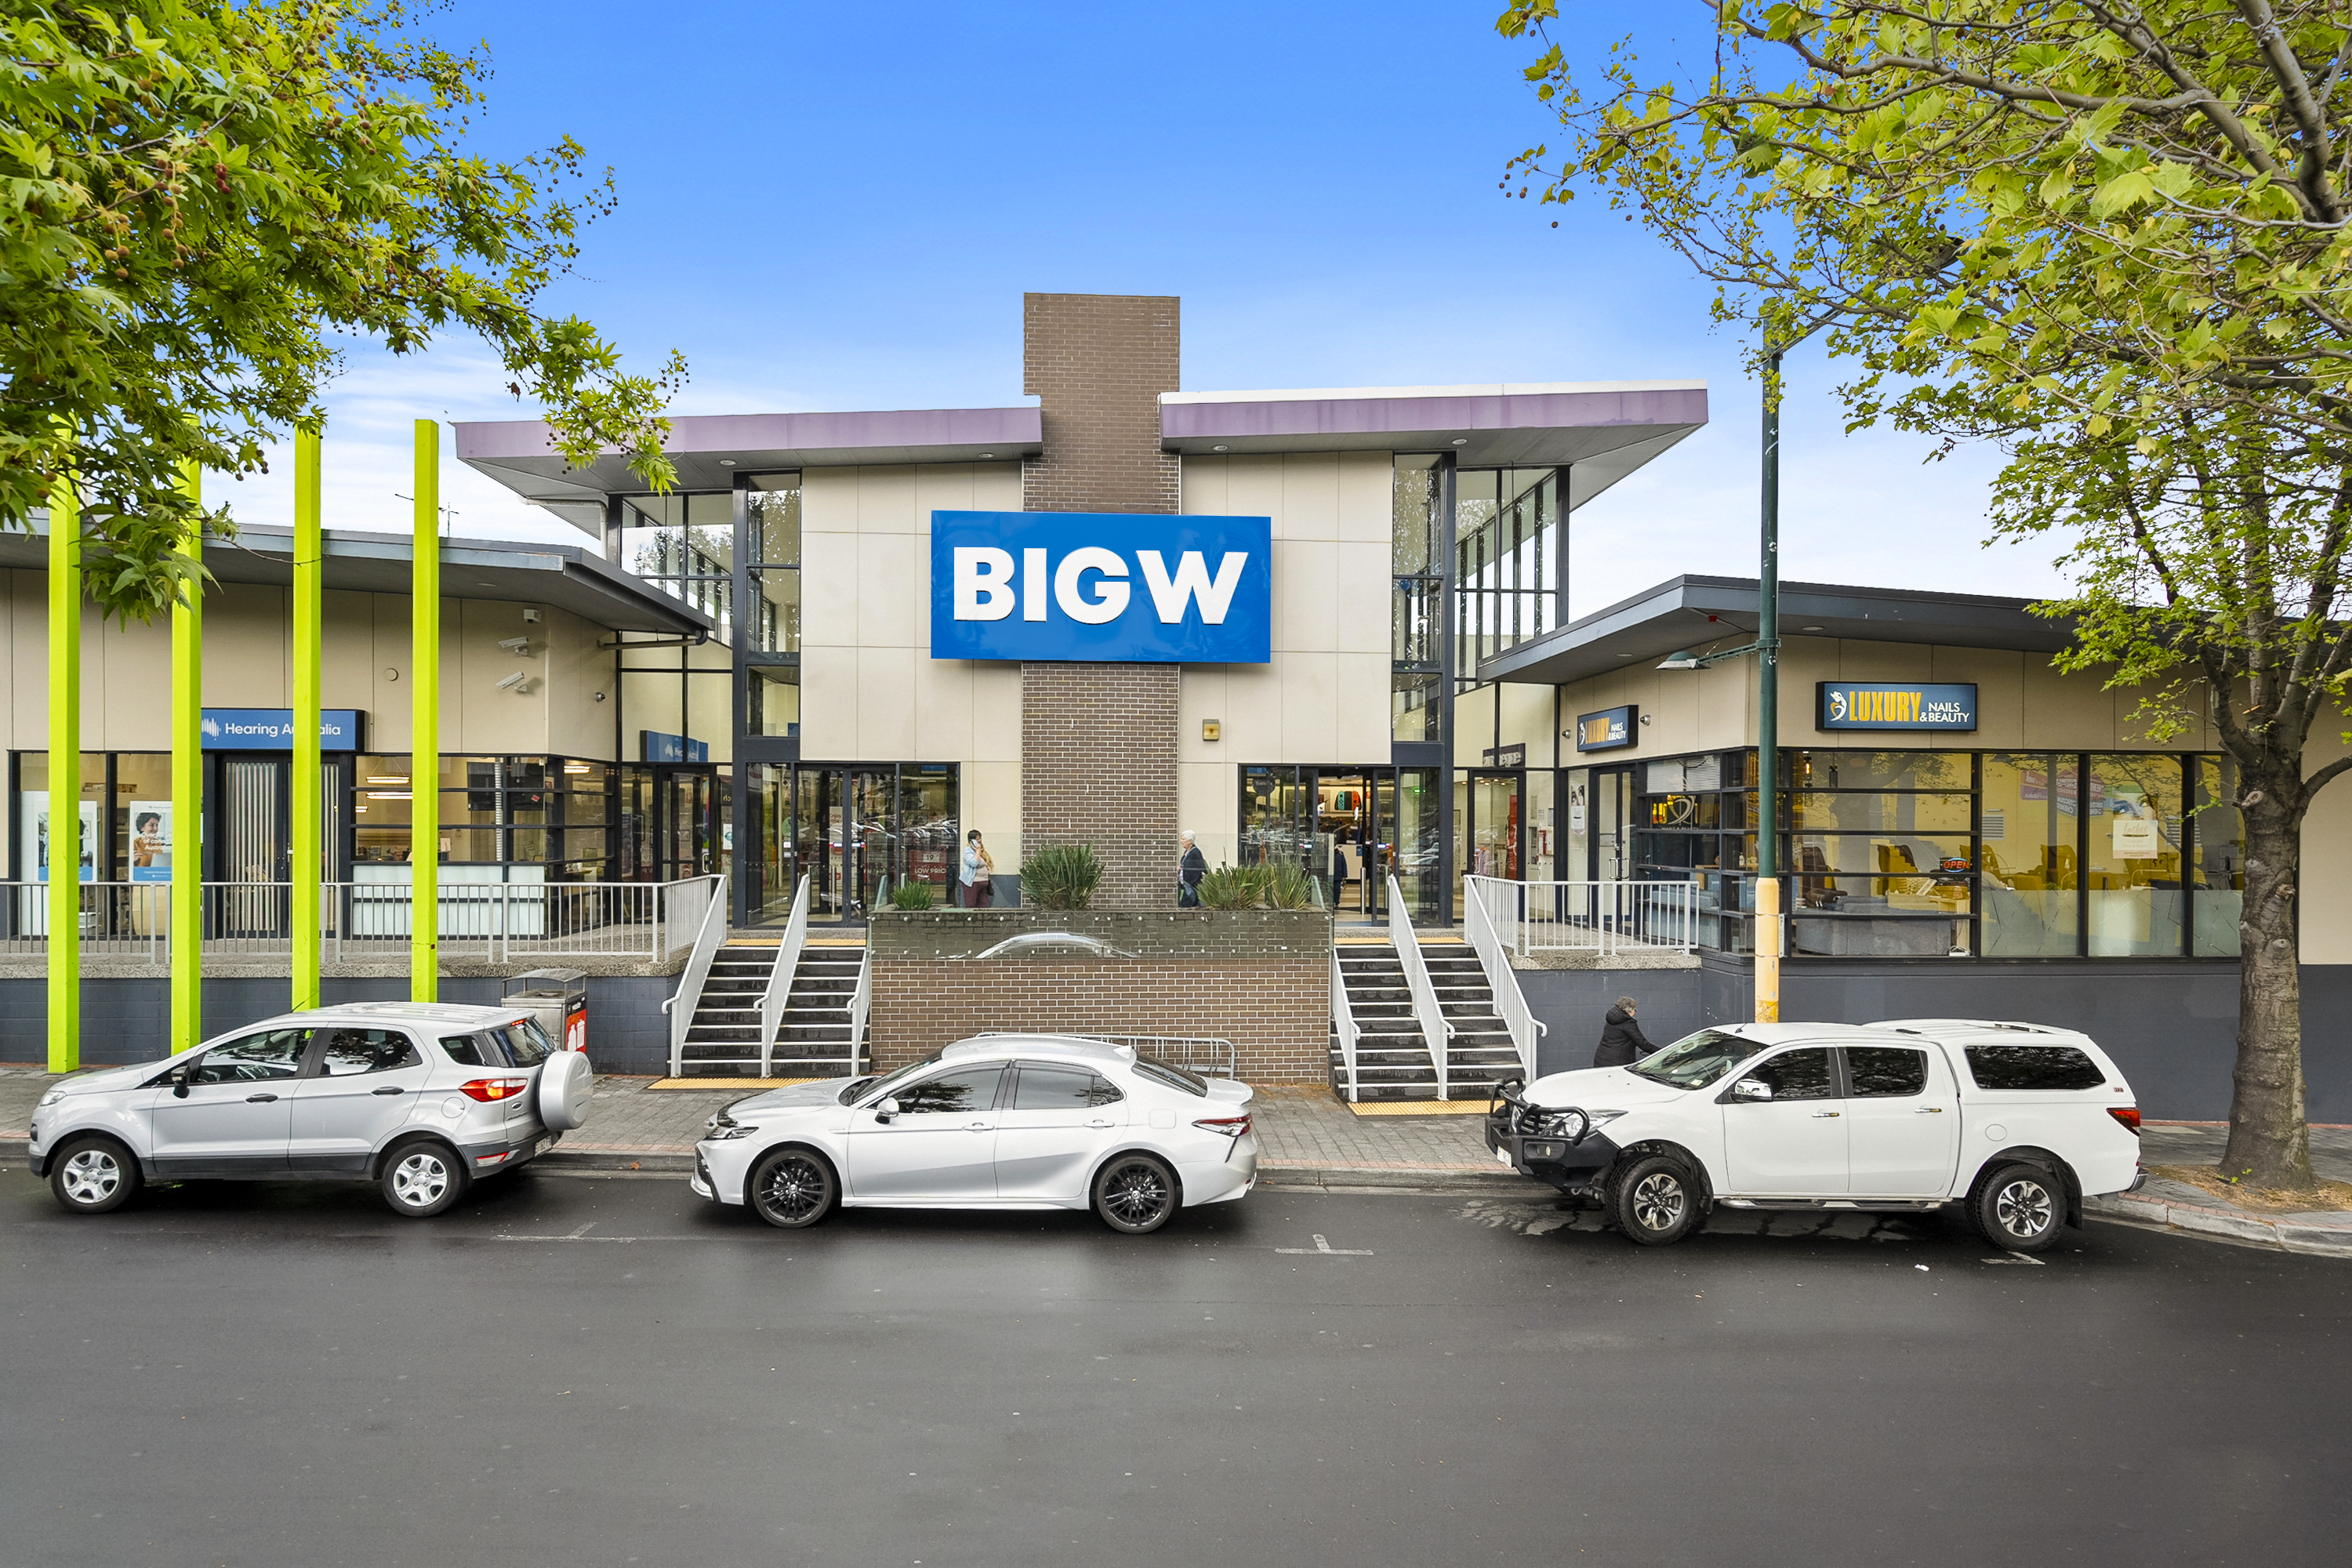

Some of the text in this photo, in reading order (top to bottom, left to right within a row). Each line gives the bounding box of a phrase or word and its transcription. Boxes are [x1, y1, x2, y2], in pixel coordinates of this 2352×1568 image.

[1850, 691, 1922, 722] LUXURY
[1928, 702, 1960, 713] NAILS
[225, 722, 341, 737] Hearing Aalia
[1584, 717, 1610, 744] LUXURY
[1944, 861, 1969, 869] OPEN
